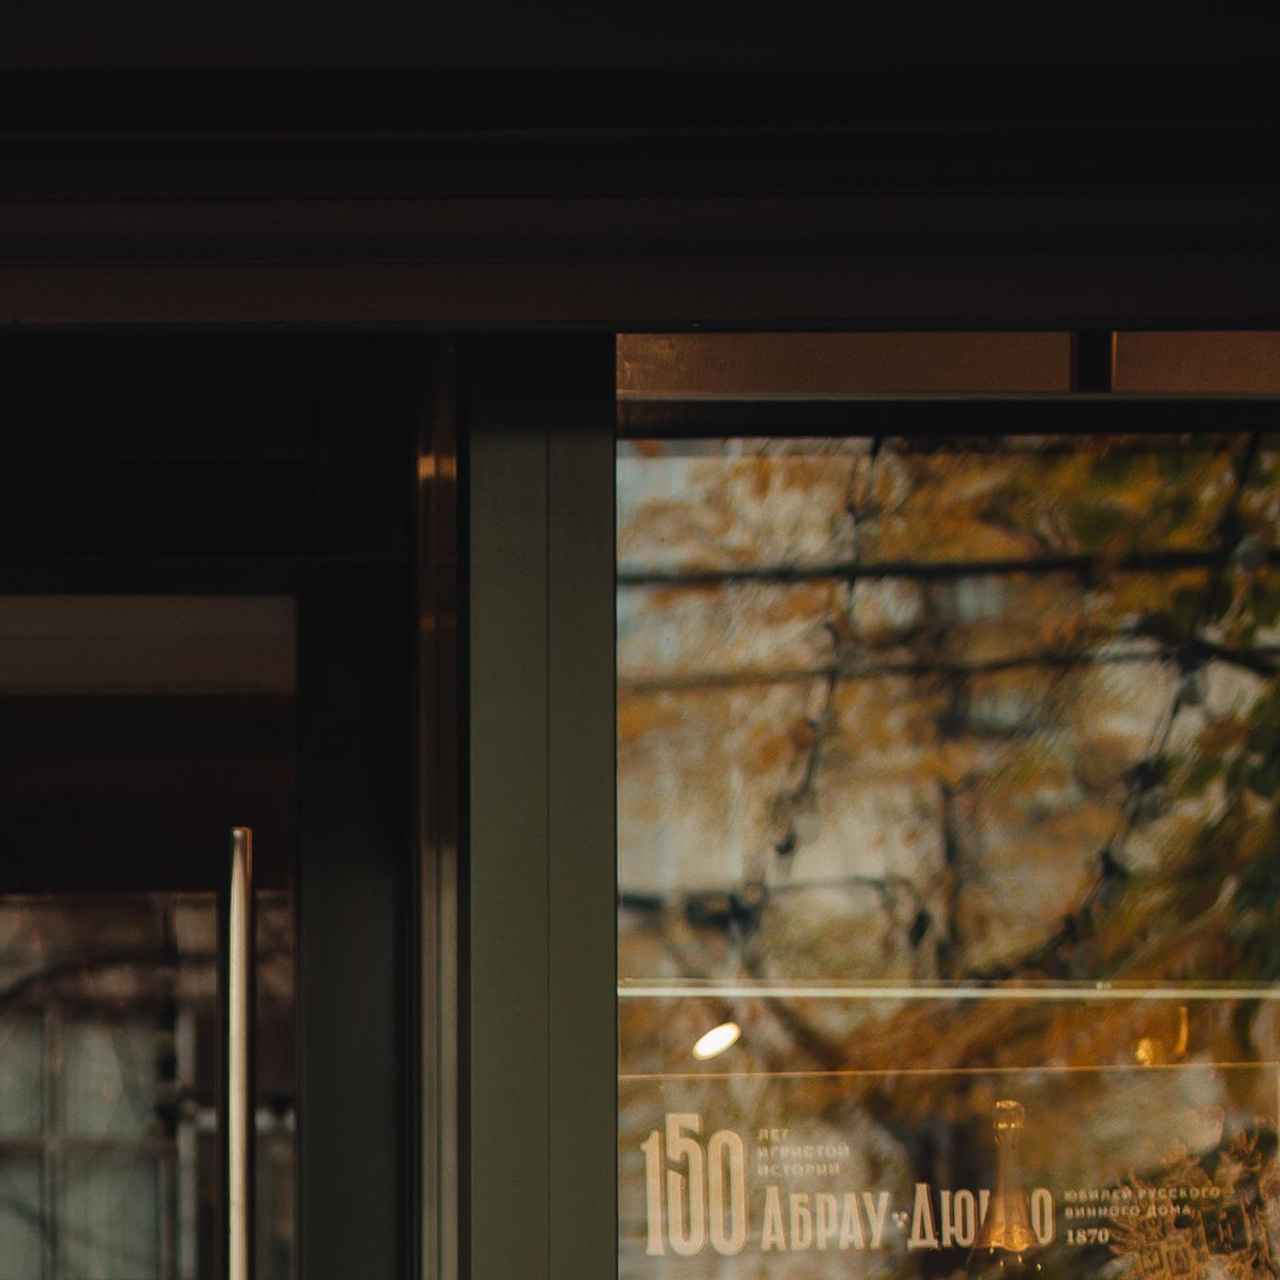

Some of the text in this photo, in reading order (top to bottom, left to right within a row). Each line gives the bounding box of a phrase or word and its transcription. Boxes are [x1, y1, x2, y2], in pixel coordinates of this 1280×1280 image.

[639, 1113, 749, 1256] 150
[907, 1182, 1054, 1250] ДЮО
[1065, 1228, 1110, 1246] 1870
